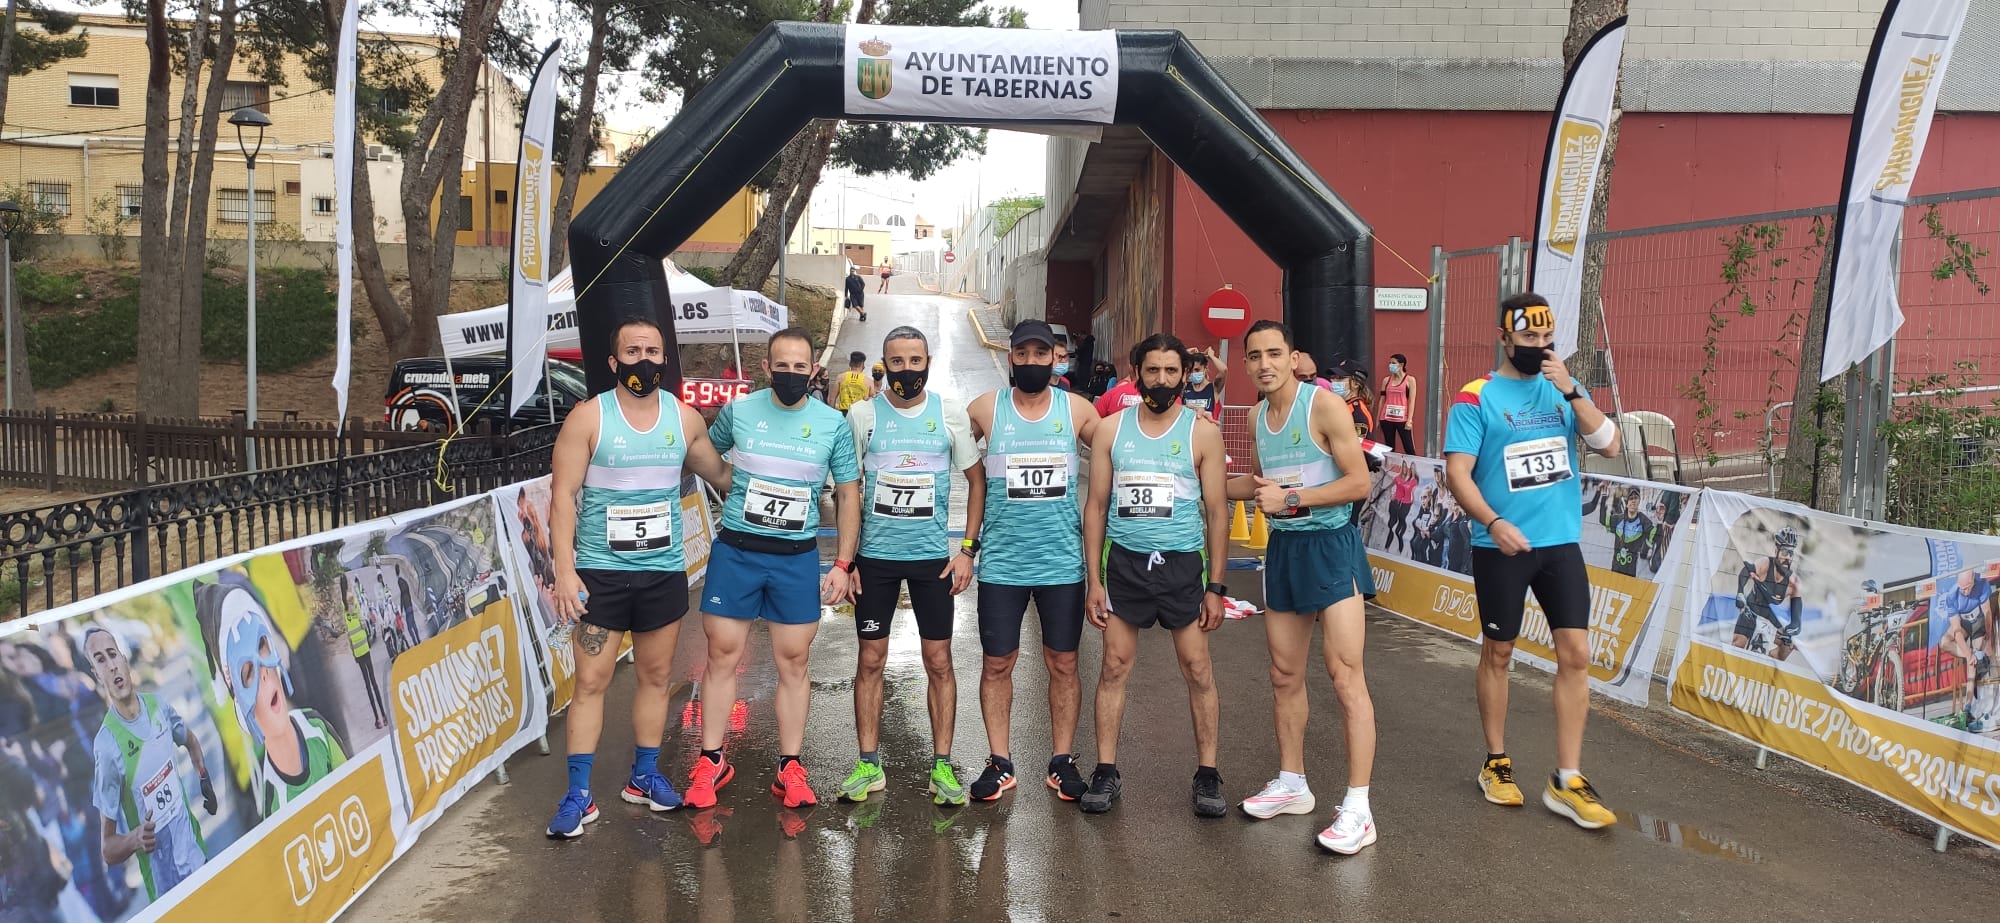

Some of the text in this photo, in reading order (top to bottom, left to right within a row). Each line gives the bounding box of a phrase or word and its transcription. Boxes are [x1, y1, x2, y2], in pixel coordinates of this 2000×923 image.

[904, 51, 1109, 77] AYUNTAMIENTO
[921, 75, 1093, 100] DE TABERNAS
[1521, 454, 1555, 475] 133
[1020, 469, 1055, 487] 107
[891, 489, 916, 506] 77
[1130, 488, 1153, 505] 38
[764, 499, 790, 517] 47
[635, 521, 647, 538] 5
[156, 783, 173, 810] 88
